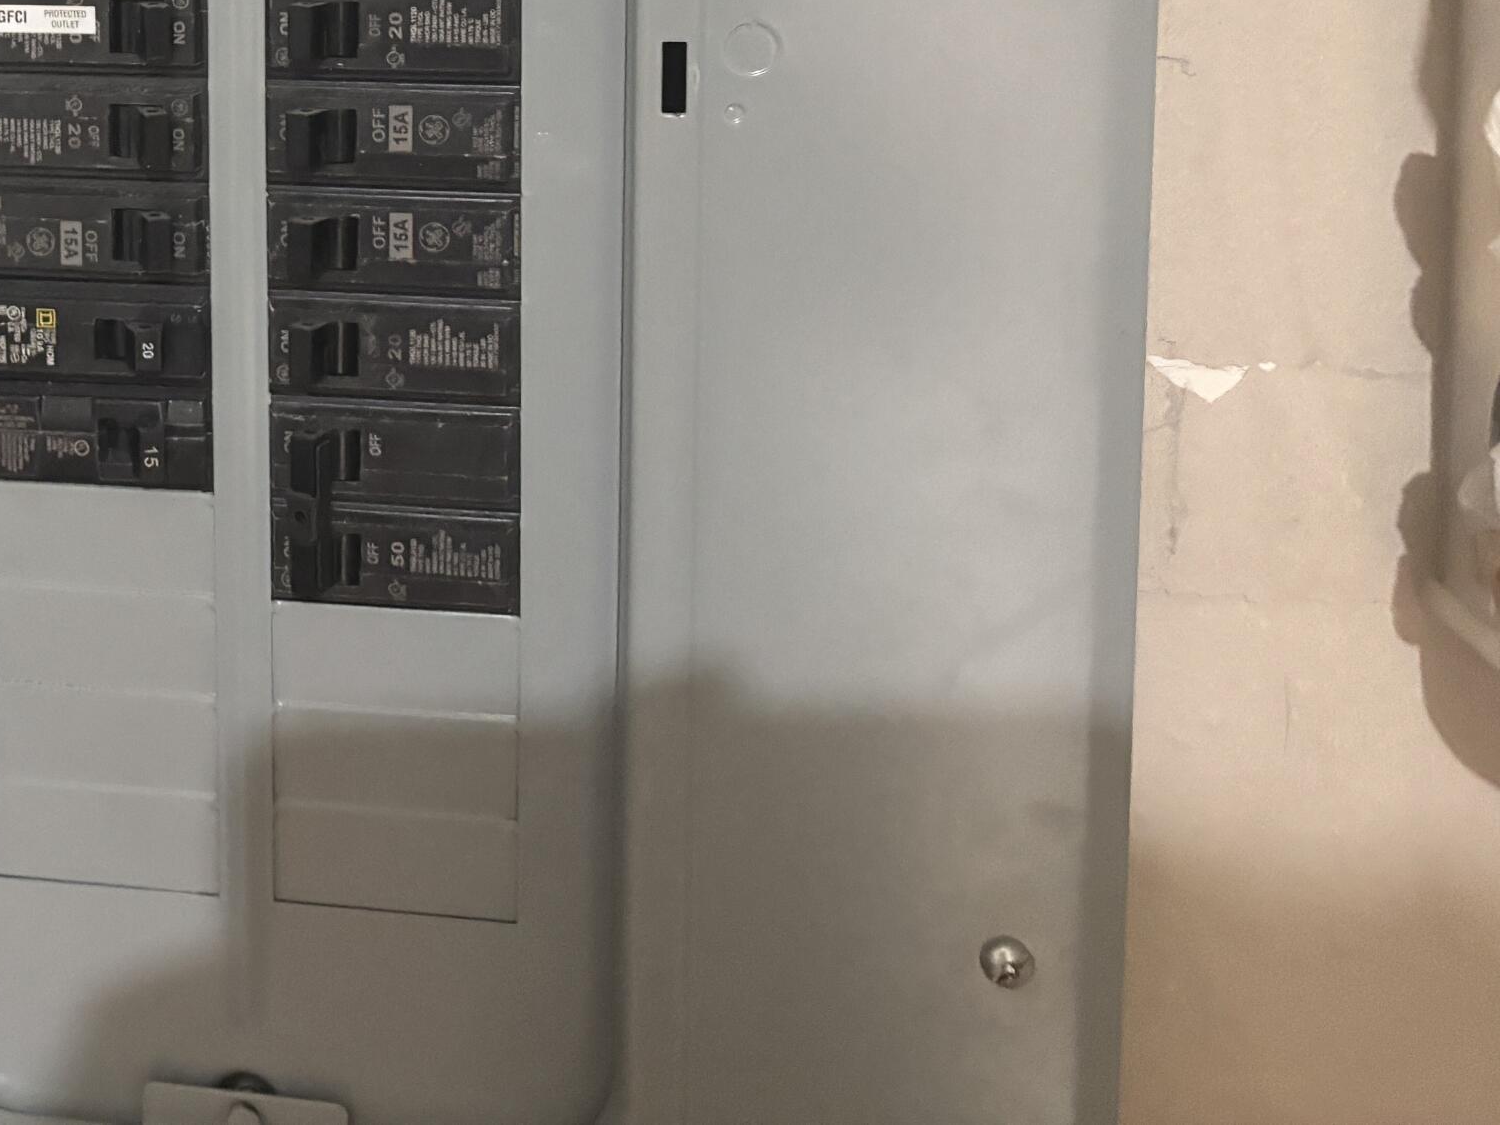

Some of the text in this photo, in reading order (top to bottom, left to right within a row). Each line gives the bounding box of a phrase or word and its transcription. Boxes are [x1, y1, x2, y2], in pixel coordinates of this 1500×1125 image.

[44, 9, 87, 19] PROTECTED
[51, 20, 79, 29] OUTLET
[279, 11, 289, 35] ON
[369, 14, 381, 37] OFF
[389, 12, 403, 39] 20
[174, 21, 186, 46] ON
[68, 124, 81, 149] 20
[88, 125, 100, 148] OFF
[372, 108, 385, 142] OFF
[393, 111, 410, 145] 15A
[174, 128, 186, 152] ON
[63, 226, 78, 261] 15A
[373, 216, 385, 249] OFF
[394, 219, 409, 252] 15A
[85, 230, 98, 263] OFF
[174, 233, 186, 258] ON
[47, 345, 55, 366] HOM
[142, 342, 154, 359] 20
[388, 334, 403, 360] 20
[369, 433, 382, 456] OFF
[144, 447, 159, 468] 15
[367, 542, 379, 564] OFF
[390, 541, 405, 567] 50
